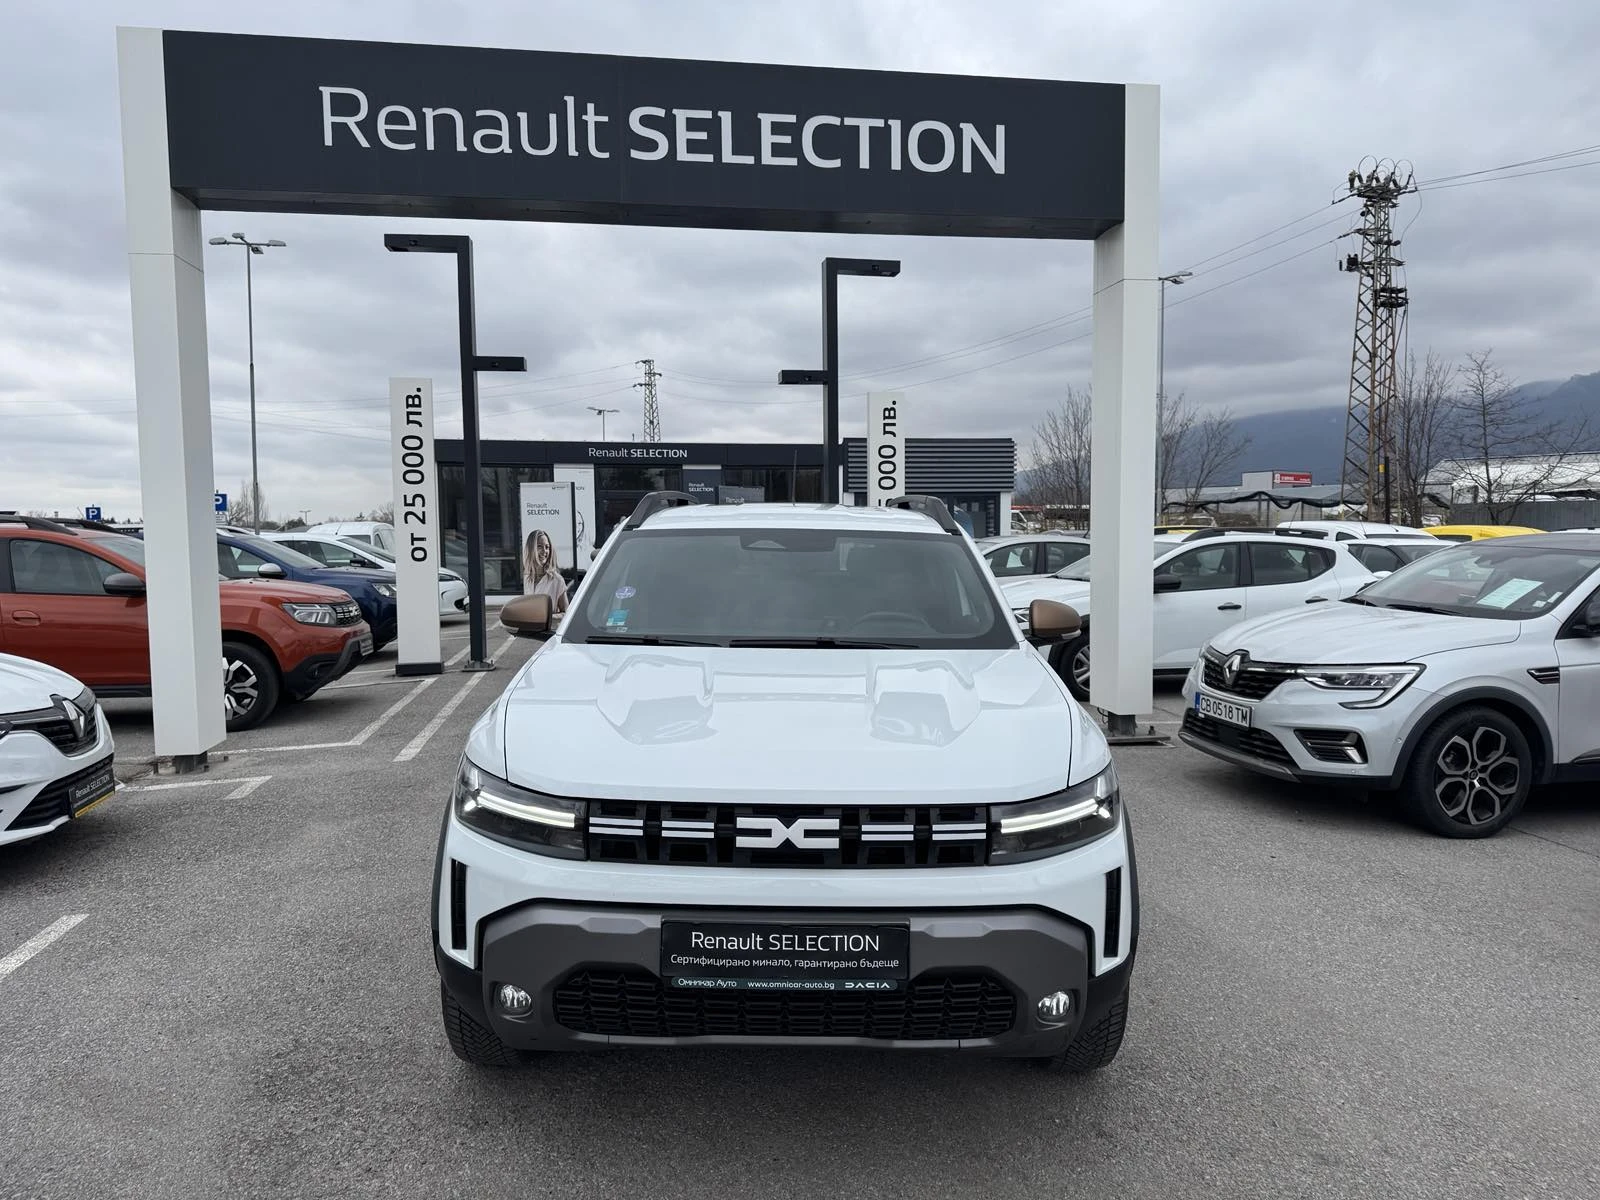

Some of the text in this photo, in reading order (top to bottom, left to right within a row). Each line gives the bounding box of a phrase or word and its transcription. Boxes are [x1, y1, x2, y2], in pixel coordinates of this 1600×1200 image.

[319, 86, 1007, 175] Renault SELECTION
[882, 400, 897, 437] лв.
[588, 447, 688, 458] Renault SELECTION
[401, 387, 428, 562] от 25 000 лв.
[878, 444, 896, 490] 000
[89, 508, 98, 519] P
[691, 931, 880, 952] Renault SELECTION
[670, 954, 900, 970] Сертифицирано минало, гарантирано бъдеще
[716, 979, 738, 988] Ауто
